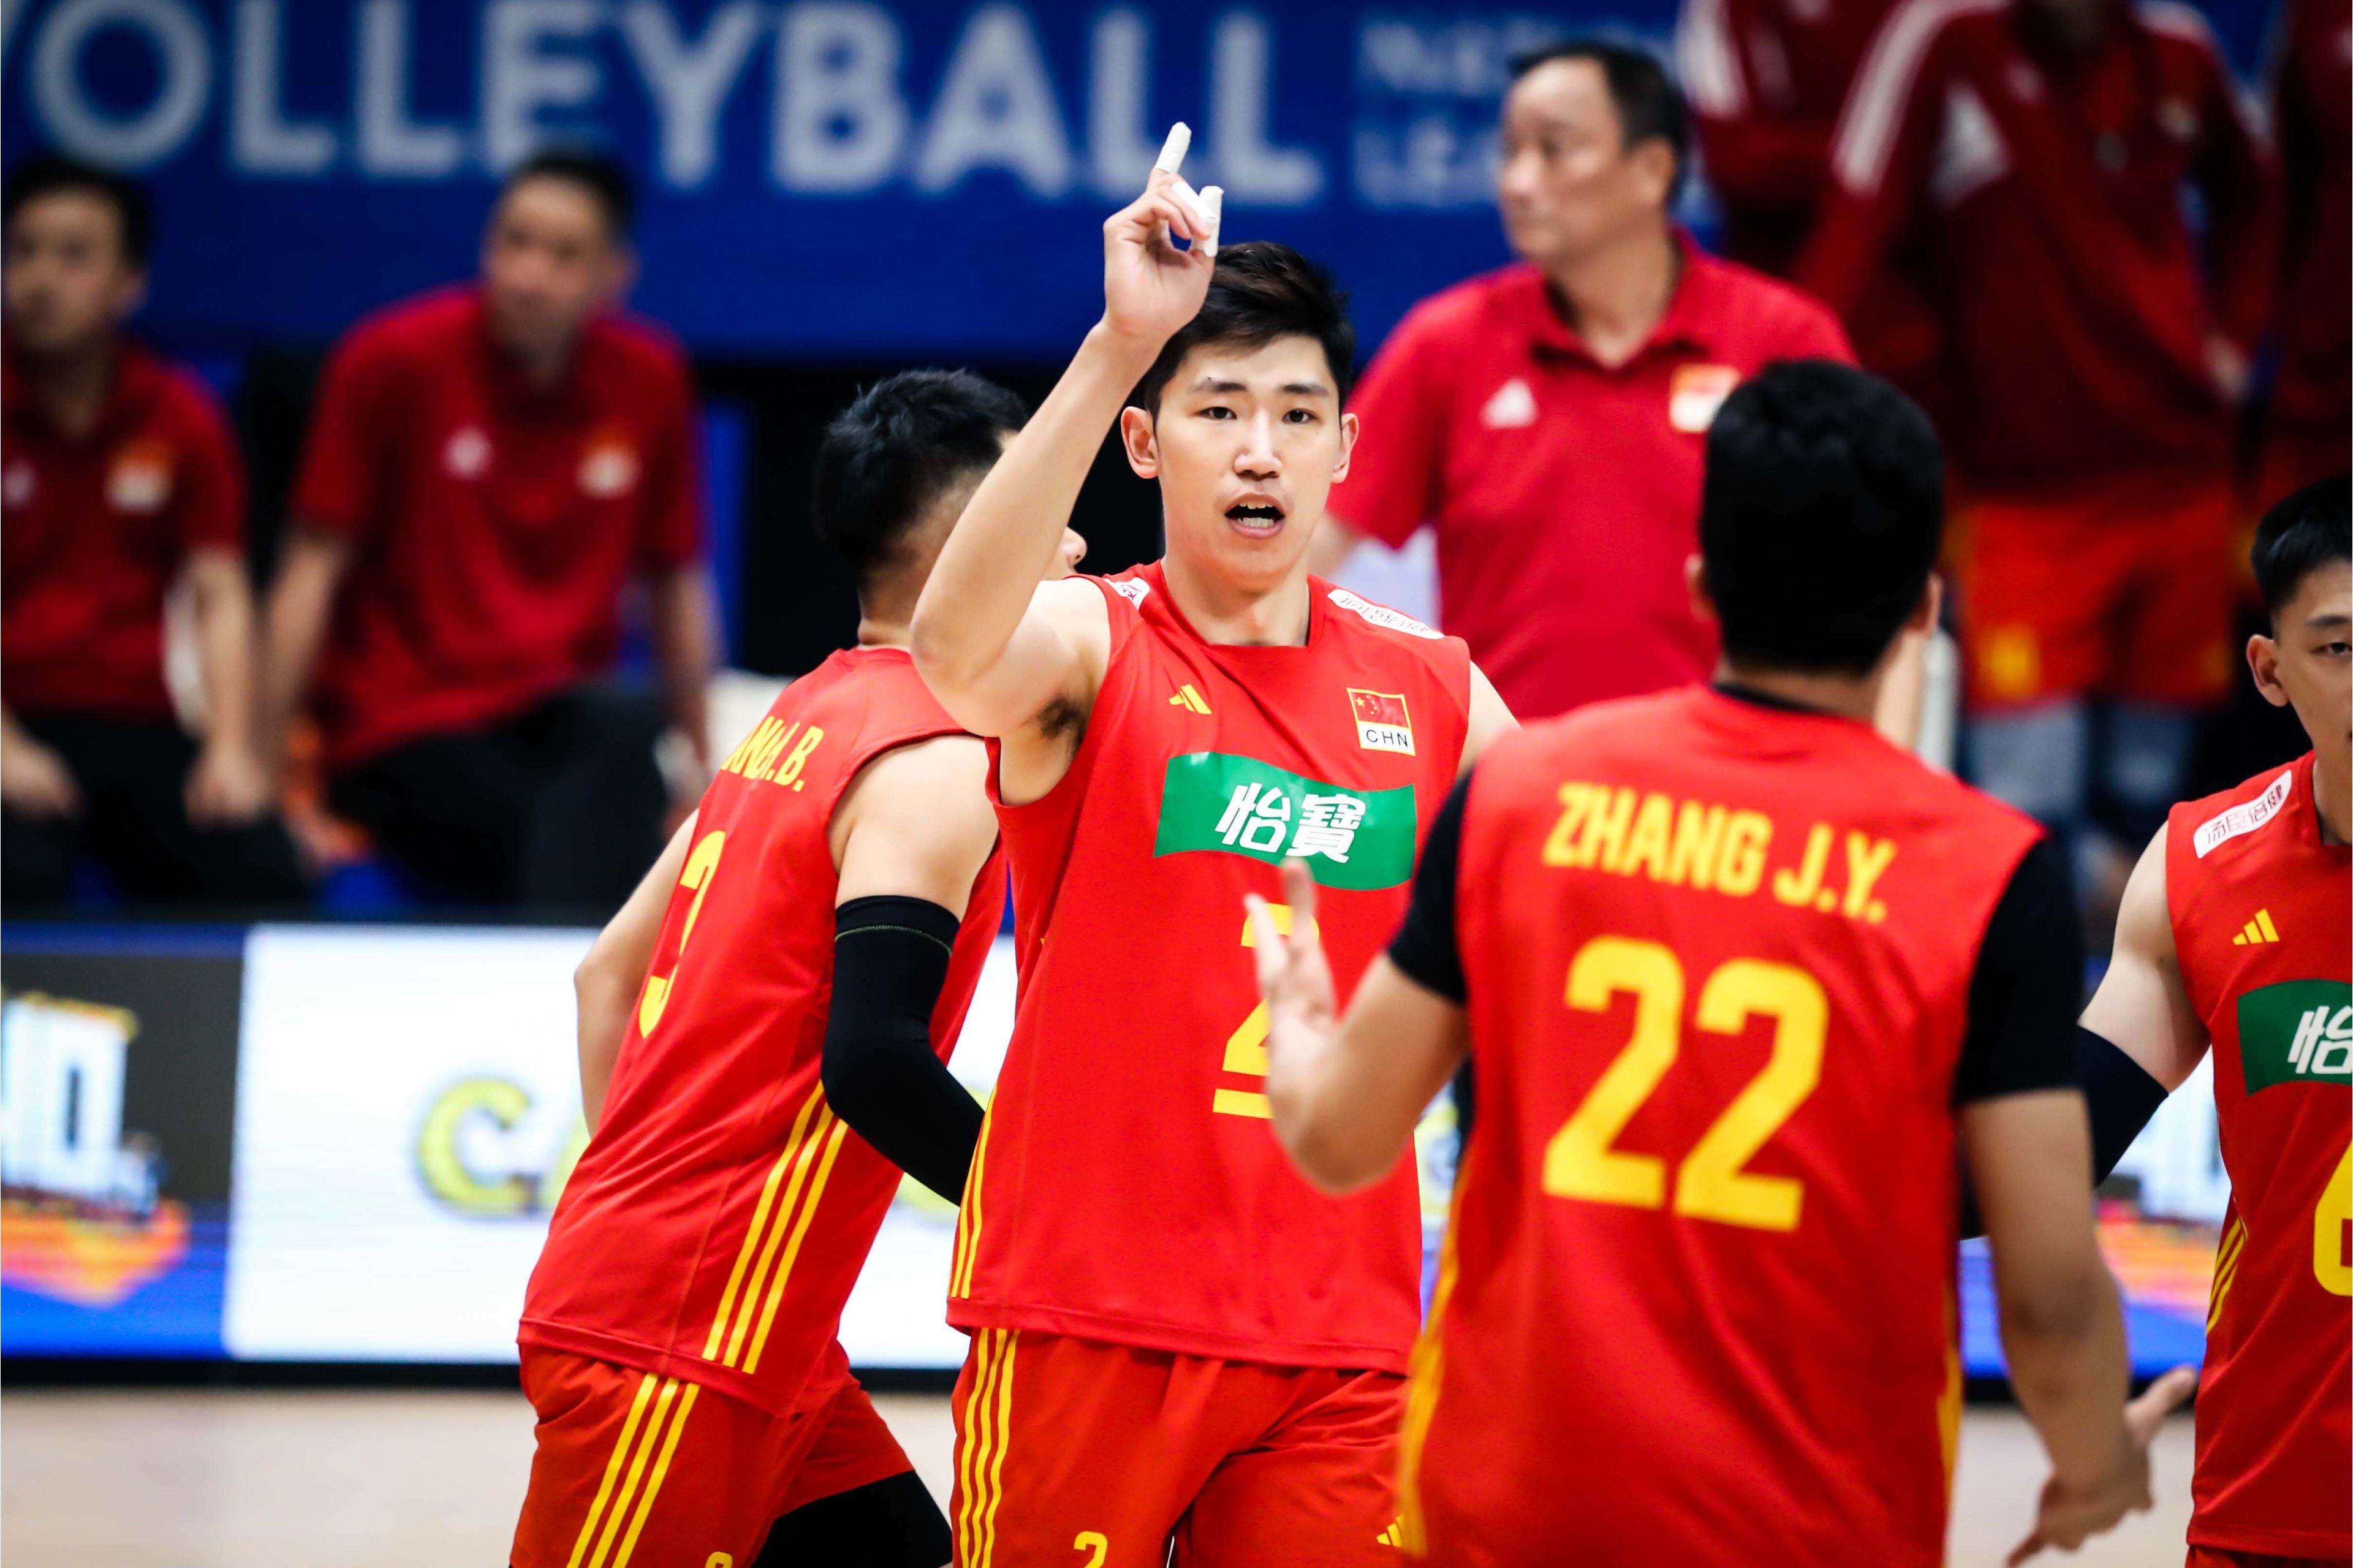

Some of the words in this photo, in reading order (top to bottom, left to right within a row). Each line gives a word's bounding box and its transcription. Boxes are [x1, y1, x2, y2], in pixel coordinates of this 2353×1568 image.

[1, 0, 1324, 205] OLLEYBALL
[1366, 729, 1408, 748] CHN
[1214, 782, 1366, 863] 怡寶
[1541, 781, 1773, 897] ZHANG
[1772, 821, 1898, 924] J.Y.
[1542, 933, 1830, 1233] 22
